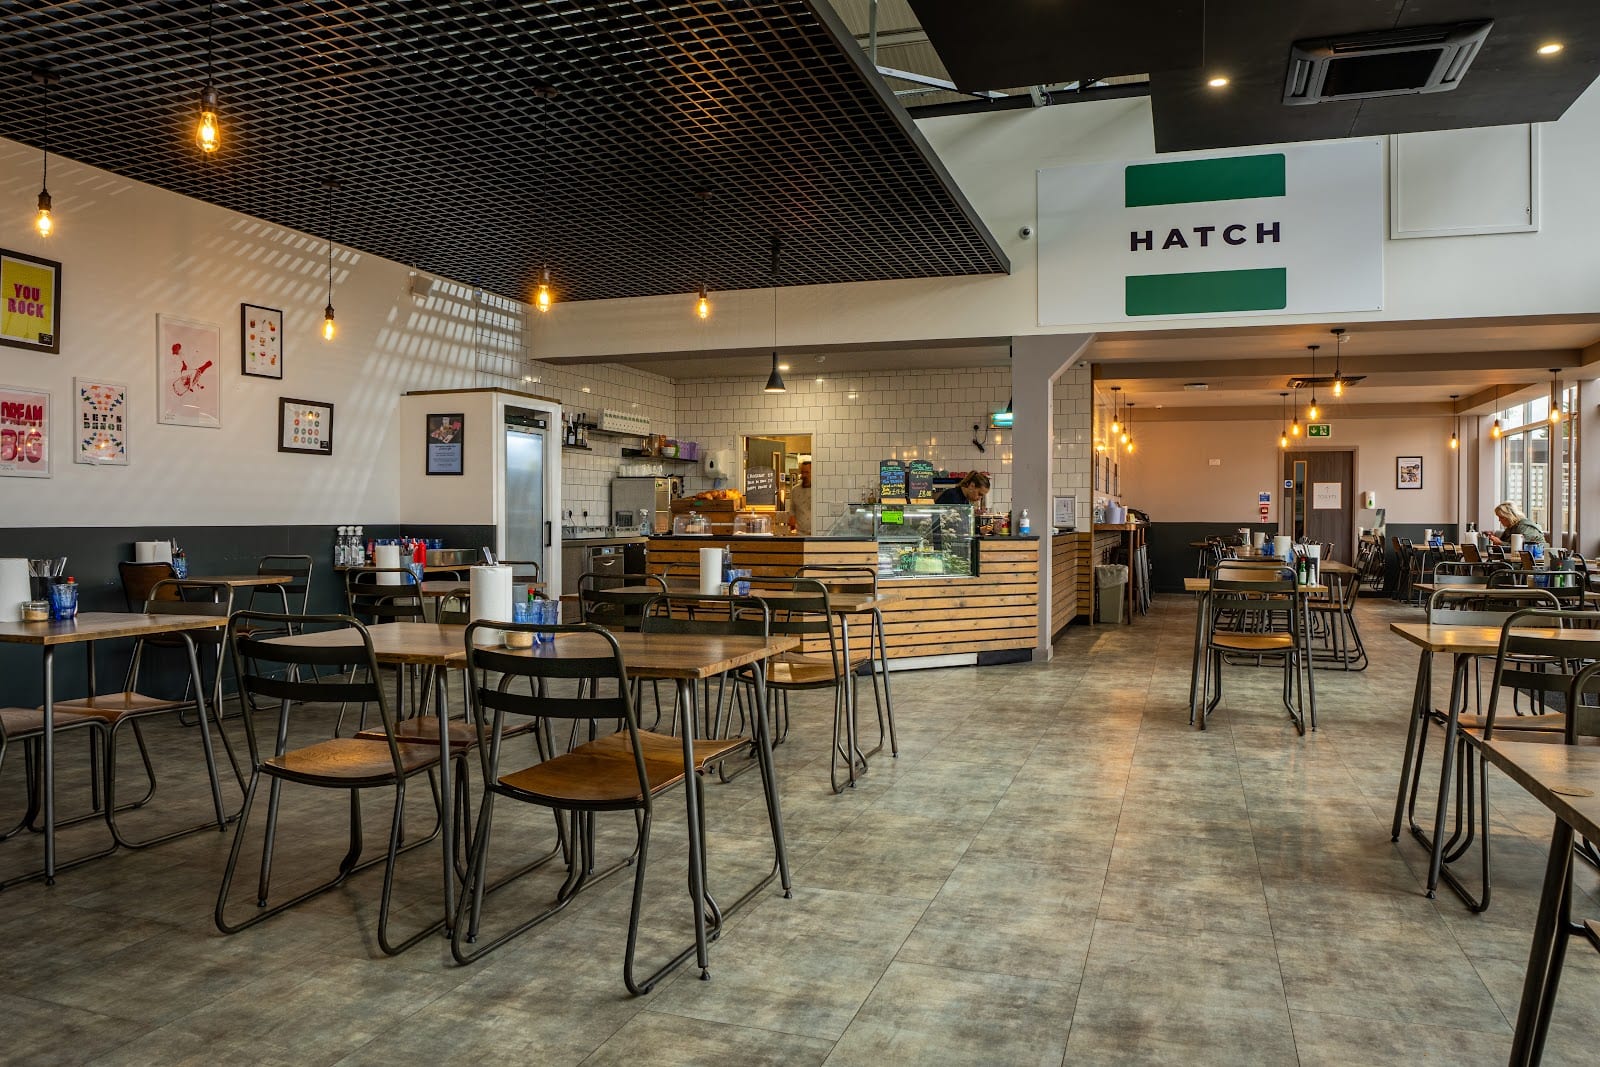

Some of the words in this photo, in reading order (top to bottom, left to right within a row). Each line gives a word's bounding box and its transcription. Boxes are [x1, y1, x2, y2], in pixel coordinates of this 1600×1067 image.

[1130, 221, 1281, 252] HATCH
[13, 283, 40, 301] YOU
[7, 298, 44, 318] ROCK
[1, 402, 43, 427] DREAM
[84, 413, 122, 423] LET'S
[84, 421, 122, 431] DANCE
[1, 428, 43, 463] BIG
